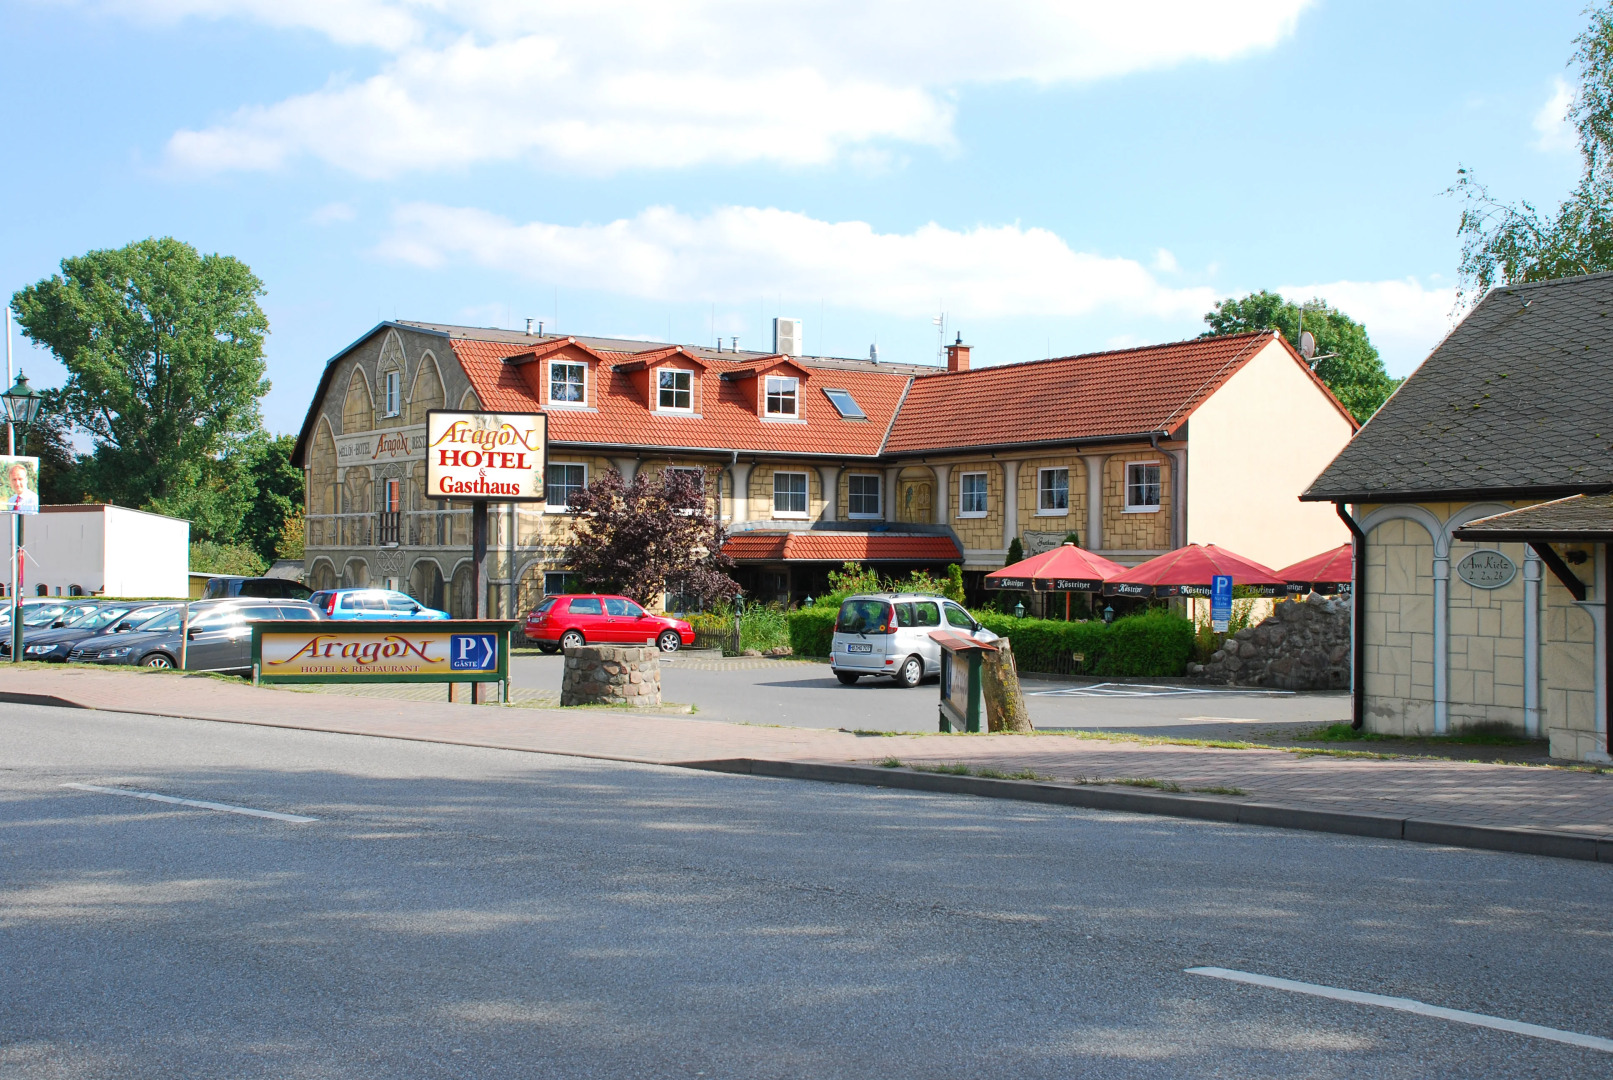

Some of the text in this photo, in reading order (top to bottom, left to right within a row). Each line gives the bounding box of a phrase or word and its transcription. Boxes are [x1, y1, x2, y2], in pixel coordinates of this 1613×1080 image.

[438, 449, 532, 469] HOTEL
[479, 468, 487, 476] &
[439, 476, 520, 495] Gasthaus
[1463, 556, 1508, 569] Am Kietz
[1057, 579, 1091, 589] Köstritzer
[1217, 577, 1228, 594] P
[457, 637, 477, 660] P
[352, 665, 420, 673] RESTAURANT
[453, 660, 478, 668] GÄSTE
